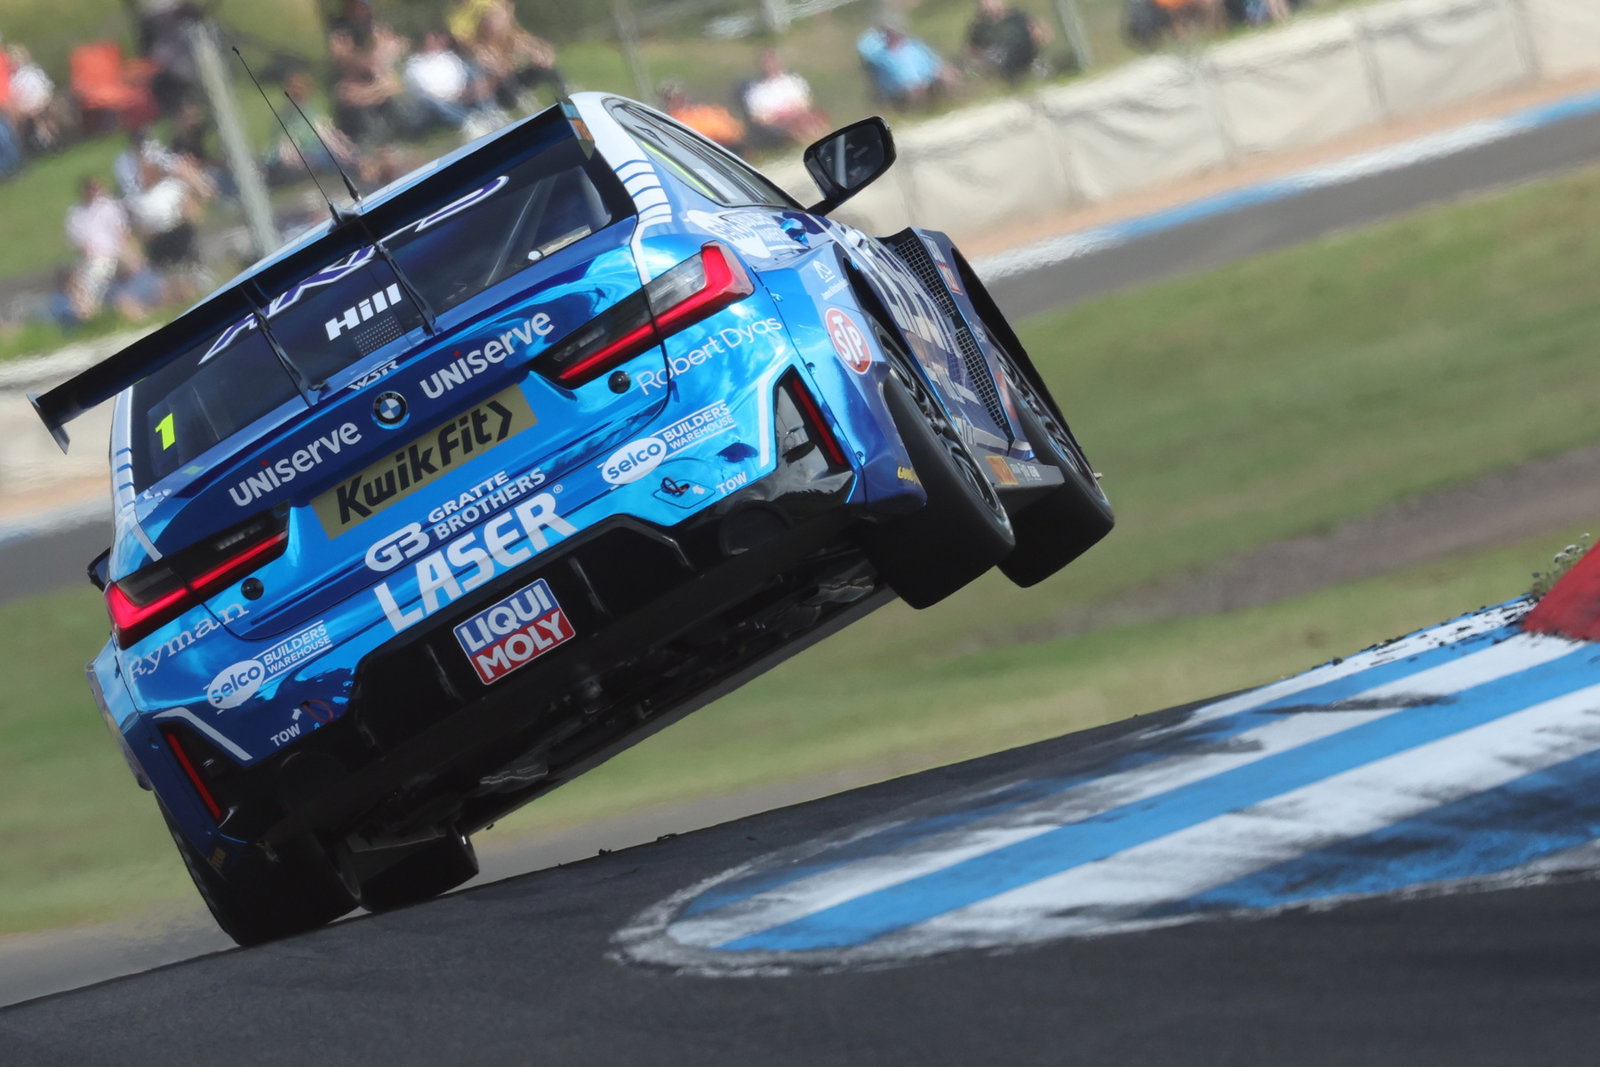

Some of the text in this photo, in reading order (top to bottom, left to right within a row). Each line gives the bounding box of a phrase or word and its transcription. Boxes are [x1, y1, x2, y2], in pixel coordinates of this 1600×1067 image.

[324, 282, 402, 341] Hill
[635, 317, 782, 396] Robert Dyas
[831, 314, 866, 369] STP
[154, 412, 176, 451] 1
[662, 402, 731, 443] BUILDERS
[668, 414, 735, 450] WAREHOUSE
[606, 441, 663, 481] selco
[427, 470, 510, 523] GRATTE
[432, 467, 547, 541] BROTHERS
[715, 472, 748, 495] TOW
[459, 582, 553, 654] LIQUI
[128, 602, 250, 683] Ryman
[263, 624, 328, 667] BUILDERS
[267, 636, 332, 675] WAREHOUSE
[475, 609, 565, 680] MOLY
[211, 664, 261, 705] selco
[270, 723, 301, 748] TOW
